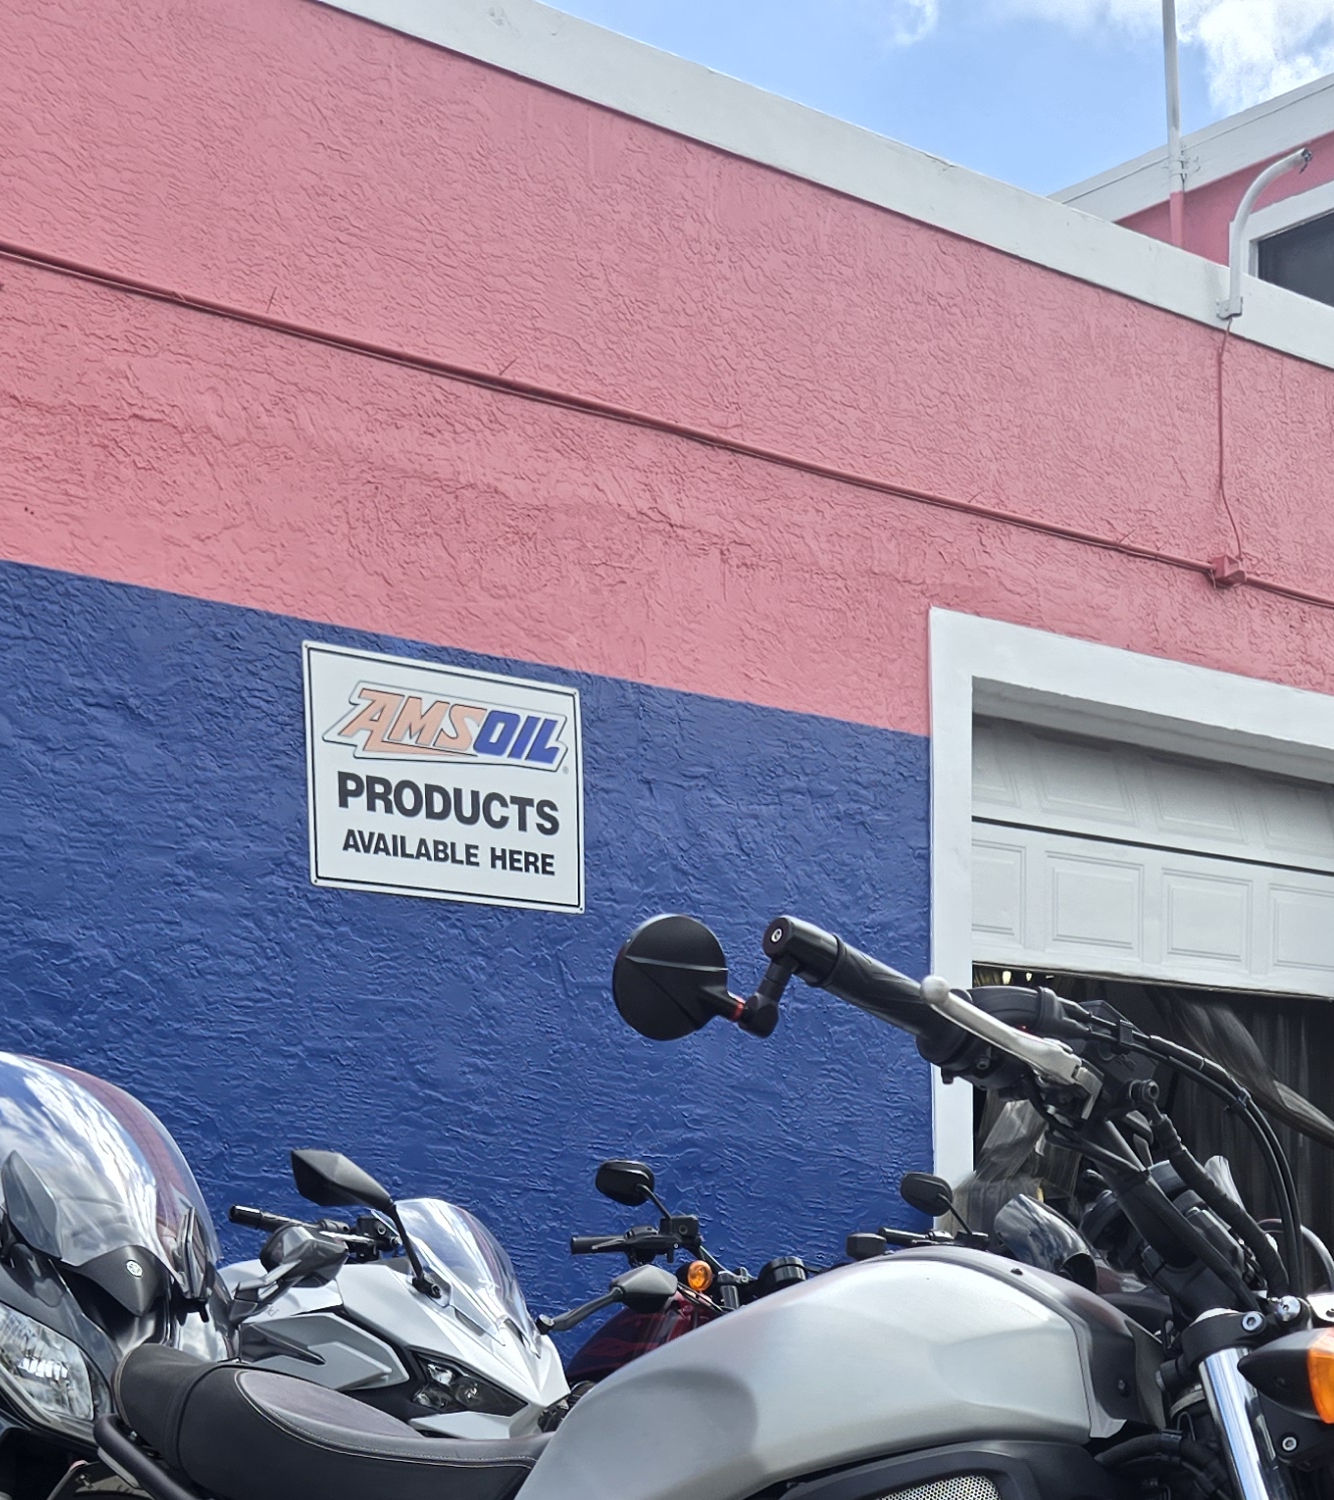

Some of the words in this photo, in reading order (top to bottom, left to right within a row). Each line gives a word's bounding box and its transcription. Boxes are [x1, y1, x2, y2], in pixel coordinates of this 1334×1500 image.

[338, 688, 561, 765] AMSOIL
[337, 770, 560, 836] PRODUCTS
[342, 829, 480, 867] AVAILABLE
[490, 846, 556, 876] HERE
